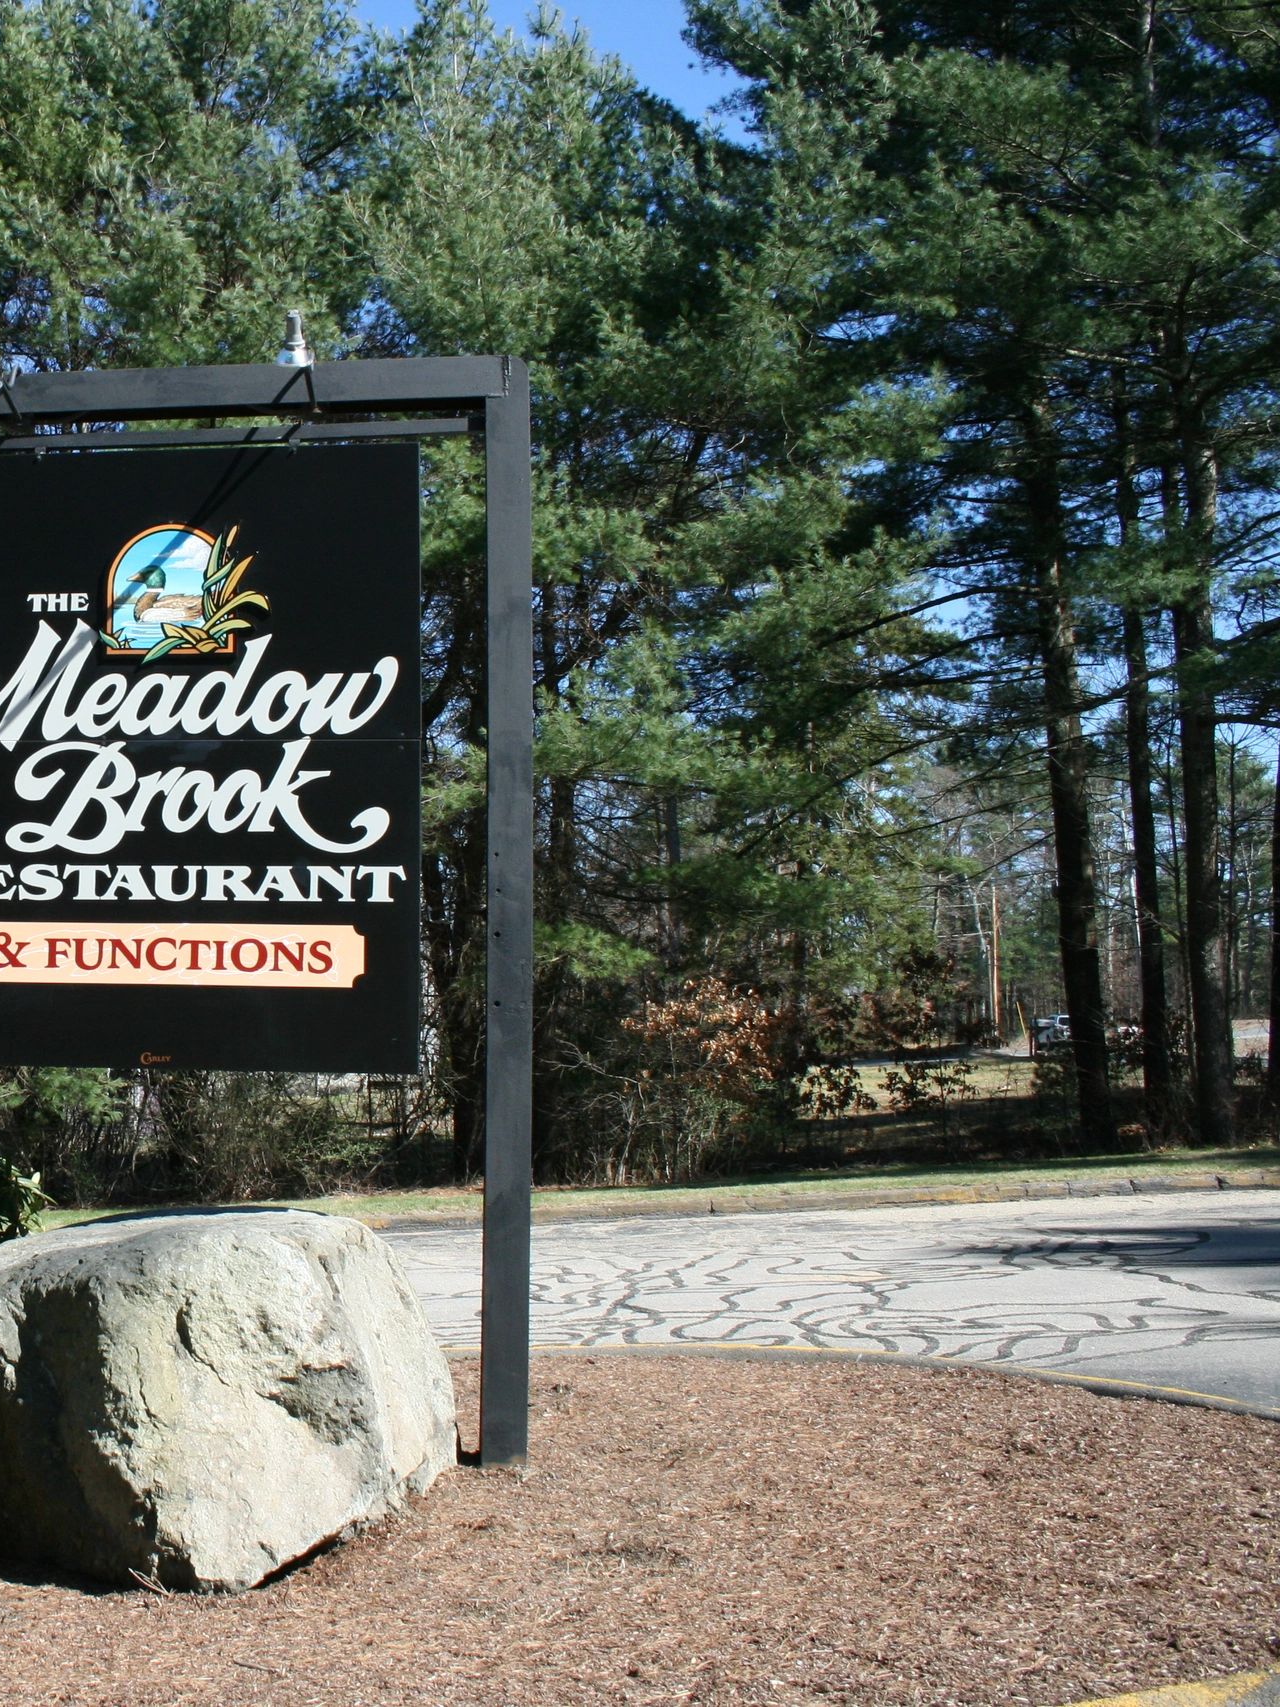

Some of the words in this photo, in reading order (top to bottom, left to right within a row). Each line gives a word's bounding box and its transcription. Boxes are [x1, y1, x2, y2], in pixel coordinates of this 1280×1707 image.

[27, 593, 89, 612] THE
[5, 737, 390, 854] Brook
[44, 937, 334, 974] FUNCTIONS
